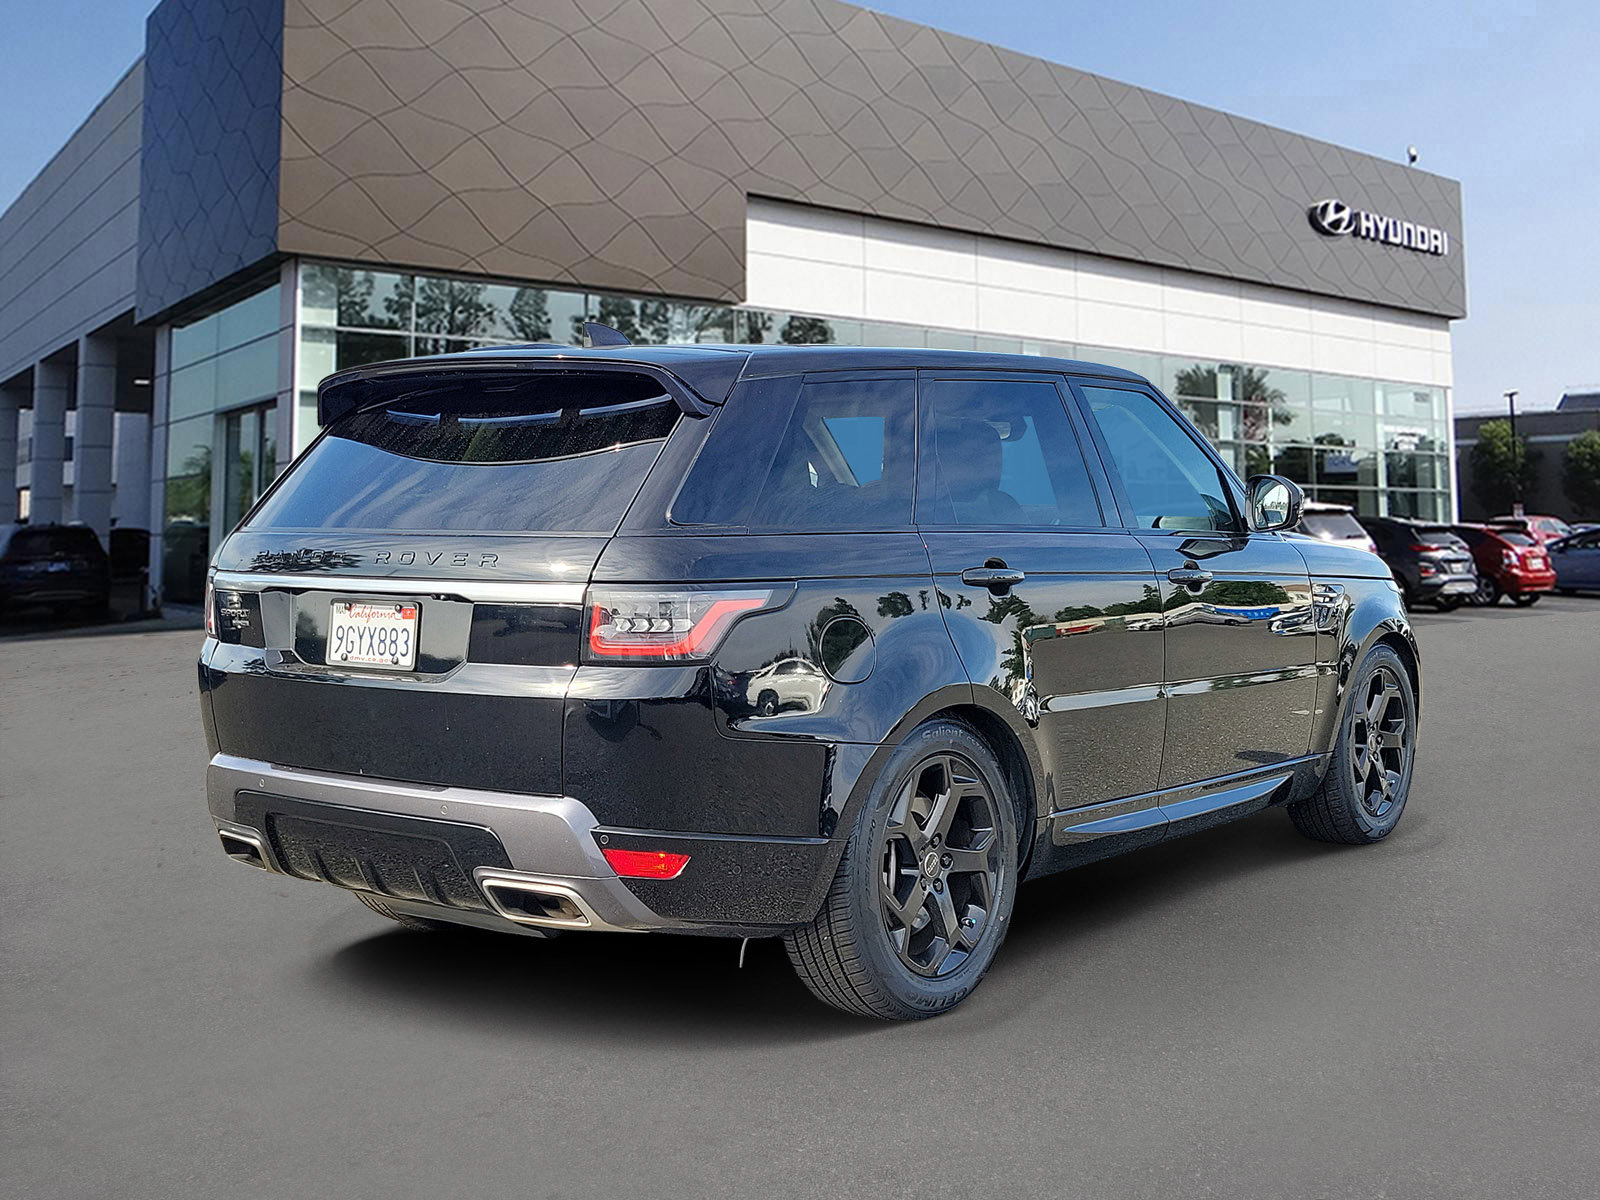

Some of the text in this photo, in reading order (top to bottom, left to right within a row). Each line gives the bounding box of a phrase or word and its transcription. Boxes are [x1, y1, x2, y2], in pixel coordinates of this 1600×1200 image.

[1360, 211, 1448, 255] HYUNDAI
[374, 551, 499, 567] ROVER
[220, 608, 250, 618] SPORT
[349, 603, 402, 623] California
[334, 625, 410, 657] 9GYX883
[921, 726, 964, 741] Salient
